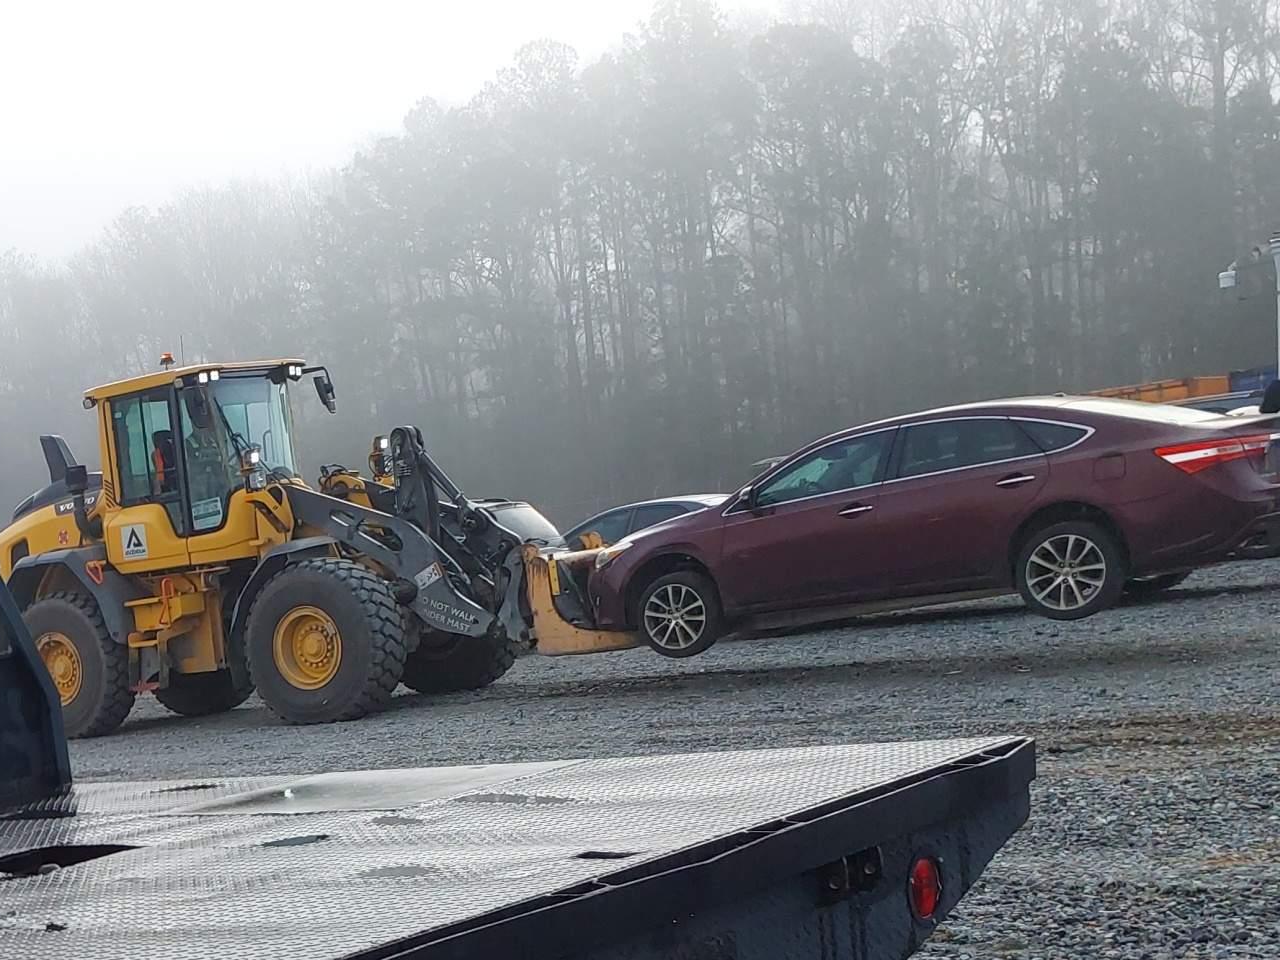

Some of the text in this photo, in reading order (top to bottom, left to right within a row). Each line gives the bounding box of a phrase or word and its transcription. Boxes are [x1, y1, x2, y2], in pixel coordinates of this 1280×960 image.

[423, 609, 470, 632] NDER MAST
[430, 600, 449, 612] NOT
[451, 607, 476, 622] WALK
